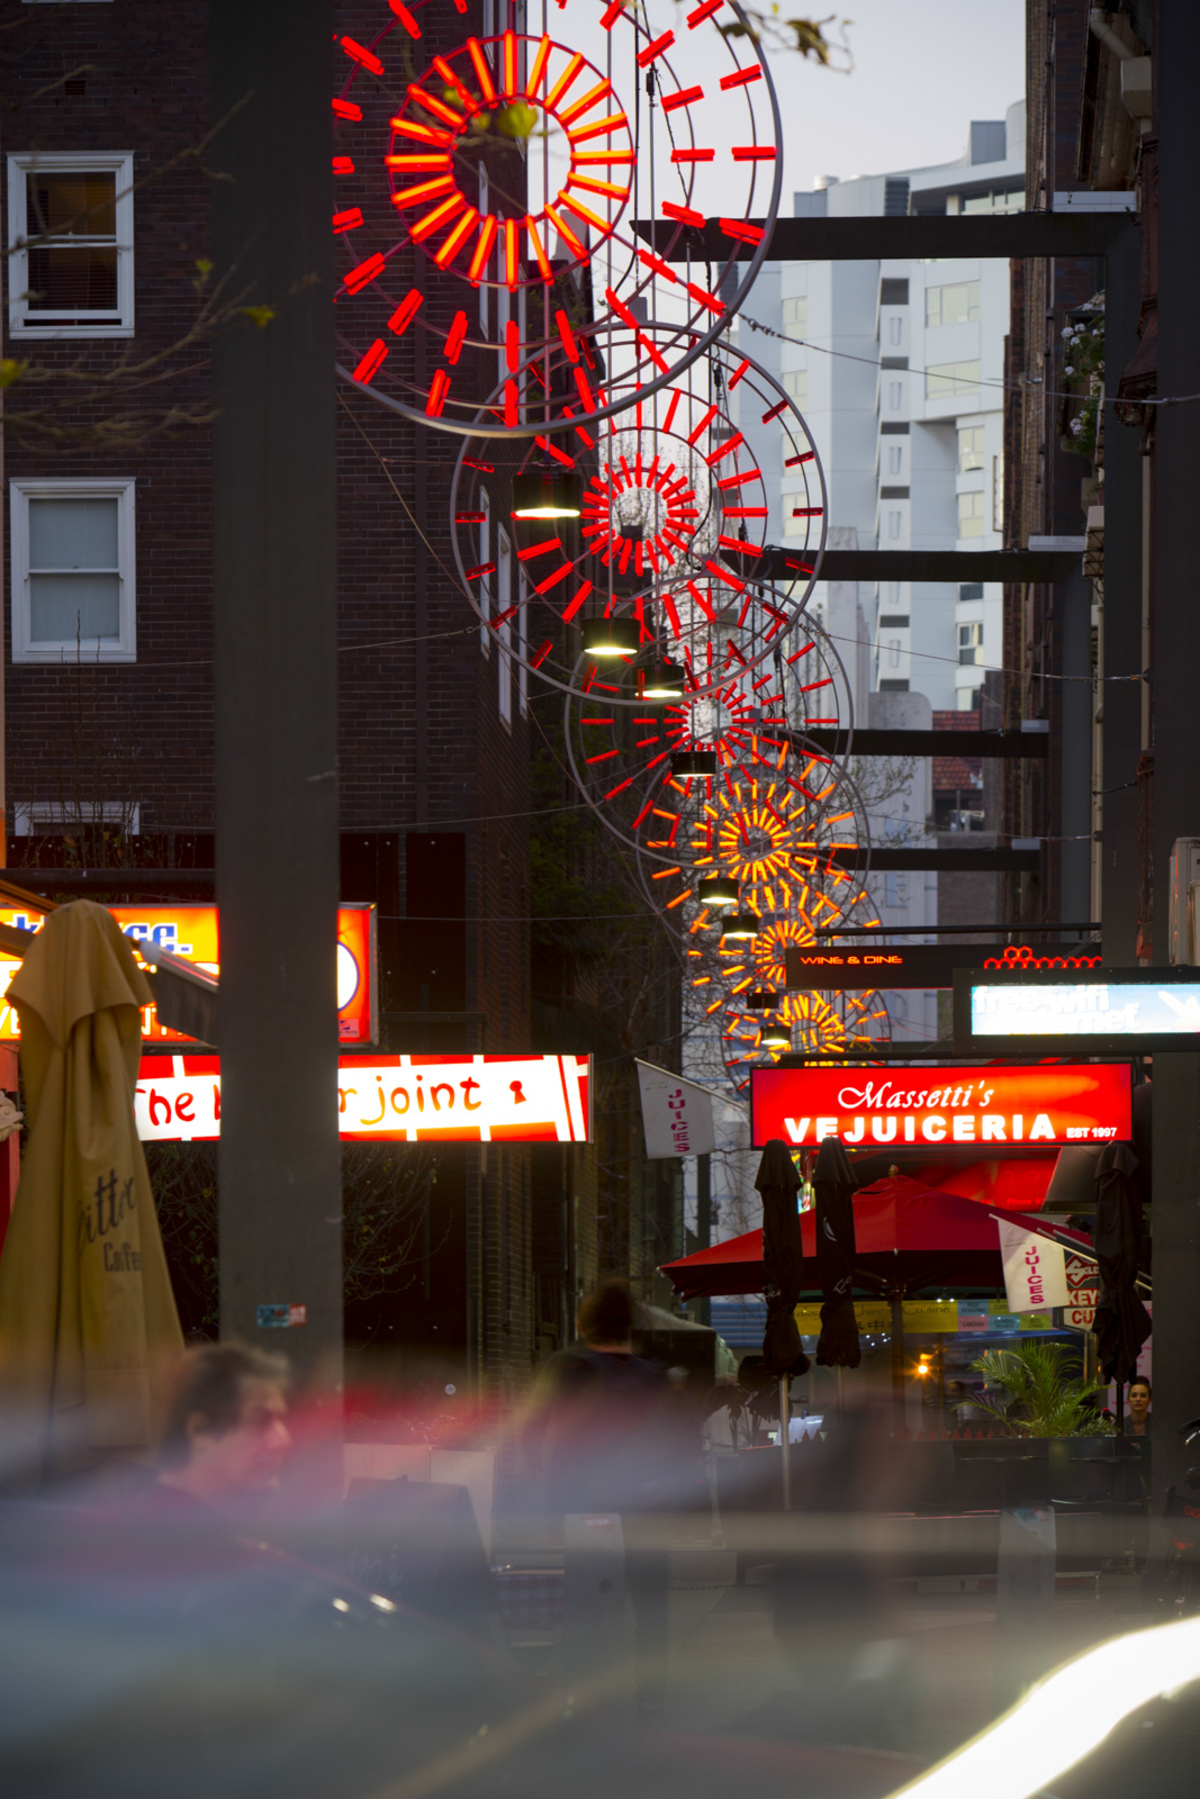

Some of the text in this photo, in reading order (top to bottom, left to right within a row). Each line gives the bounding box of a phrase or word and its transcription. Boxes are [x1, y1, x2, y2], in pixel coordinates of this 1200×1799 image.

[800, 955, 903, 965] WINE & DINE
[974, 985, 1110, 1014] free wifi
[360, 1074, 482, 1126] joint
[838, 1080, 995, 1109] Massetti's
[667, 1088, 691, 1153] JUICES
[784, 1113, 1057, 1143] VEJUICERIA
[1066, 1126, 1118, 1139] EST 1997
[1024, 1245, 1045, 1304] JUICES
[901, 1302, 950, 1316] Cuisine
[1071, 1309, 1096, 1325] CU
